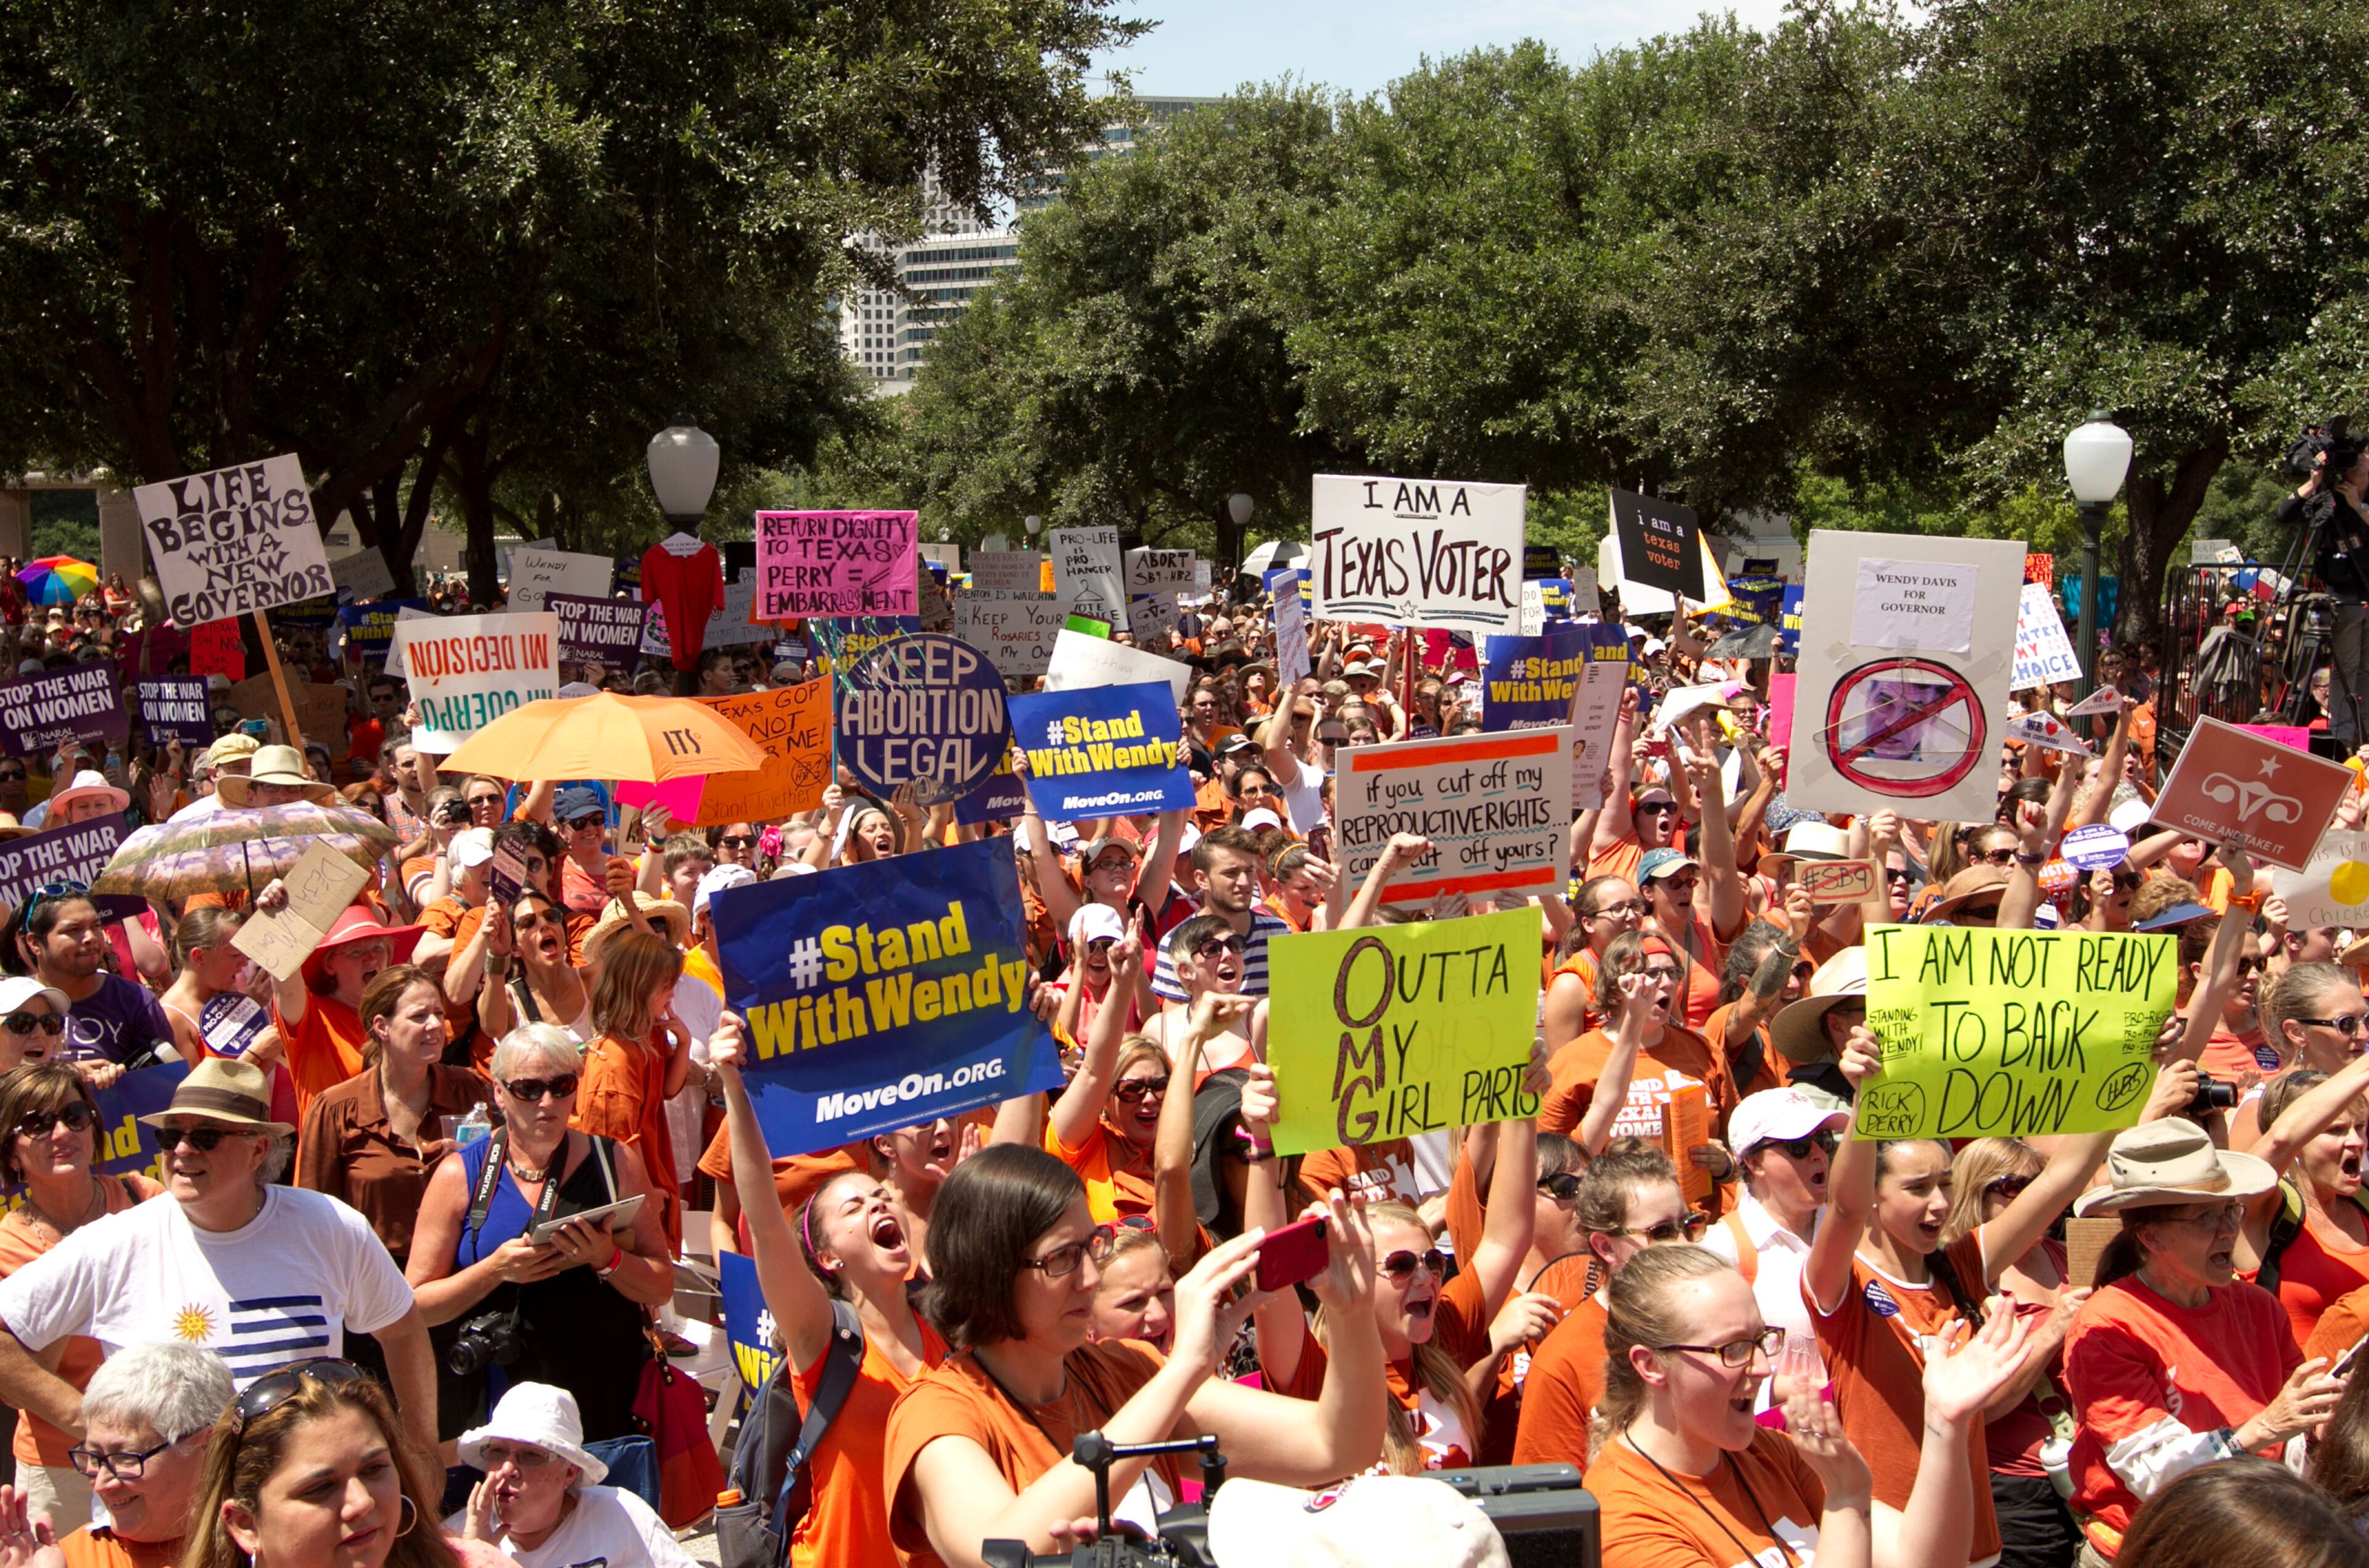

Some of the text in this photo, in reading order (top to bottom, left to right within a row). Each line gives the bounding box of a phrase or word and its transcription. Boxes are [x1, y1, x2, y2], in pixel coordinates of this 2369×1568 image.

[168, 463, 270, 518] LIFE
[1363, 481, 1471, 516] I AM A
[763, 517, 910, 543] RETURN DIGNITY
[1637, 510, 1684, 537] i am a
[187, 533, 282, 566] WITH A
[766, 538, 892, 563] TO TEXAS
[1060, 532, 1117, 545] PRO-LIFE
[1643, 532, 1681, 553] texas
[205, 551, 290, 590] NEW
[526, 556, 567, 571] WENDY
[1067, 566, 1114, 577] HANGER
[1136, 553, 1189, 569] ABORT
[1315, 527, 1518, 609] TEXAS VOTER
[1647, 550, 1681, 570] voter
[533, 574, 552, 582] FOR
[767, 562, 837, 590] PERRY
[1876, 574, 1957, 587] WENDY DAVIS
[171, 564, 330, 625] GOVERNOR
[766, 589, 912, 615] EMBARRASSMENT
[957, 589, 990, 598] DENTON
[996, 590, 1007, 600] IS
[1543, 595, 1569, 608] Wendy
[1904, 590, 1925, 600] FOR
[551, 600, 642, 624] STOP THE WAR
[972, 605, 1063, 625] KEEP YOUR
[1881, 603, 1945, 615] GOVERNOR
[581, 623, 639, 646] WOMEN
[992, 626, 1041, 642] ROSARIES
[2019, 624, 2059, 643] NTRY
[408, 635, 517, 686] DECISIÓN
[521, 633, 548, 669] MI
[576, 650, 604, 659] NARAL
[870, 640, 978, 689] KEEP
[1001, 646, 1019, 658] MY
[1511, 652, 1584, 679] #Stand
[0, 669, 109, 708] STOP THE WAR
[139, 683, 204, 699] STOP THE WAR
[706, 683, 819, 719] TEXAS GOP
[1490, 679, 1577, 703] WithWe
[4, 689, 114, 730] ON WOMEN
[143, 701, 205, 722] ON WOMEN
[842, 688, 1004, 736] ABORTION
[40, 727, 75, 740] NARAL
[76, 730, 104, 741] America
[750, 711, 804, 738] NOT
[1047, 710, 1144, 746] #Stand
[2026, 719, 2043, 732] WE
[663, 728, 701, 756] ITS
[787, 723, 825, 754] ME!
[2032, 733, 2059, 745] CUSTOMERS
[858, 738, 988, 785] LEGAL
[1027, 737, 1177, 777] WithWendy
[1366, 761, 1542, 809] if you cut off my
[703, 786, 816, 820] Stand Together
[2183, 814, 2284, 855] COME AND TAKE IT
[0, 826, 118, 880] OP THE WAR
[1461, 837, 1489, 864] off
[1495, 833, 1558, 872] yours?
[1803, 867, 1868, 894] #SB9
[98, 909, 113, 918] rica
[2309, 906, 2369, 925] Chicke
[789, 900, 971, 989] #Stand
[1873, 928, 2168, 1001] I AM NOT READY
[1334, 936, 1508, 1028] OUTTA
[746, 953, 1027, 1060] WithWendy
[1869, 1007, 1918, 1024] STANDING
[1874, 1021, 1908, 1038] WITH
[1930, 1000, 2099, 1073] TO BACK
[1333, 1020, 1418, 1102] MY
[1337, 1076, 1446, 1147] GIRL
[1867, 1091, 1909, 1112] RICK
[1937, 1068, 2080, 1134] DOWN
[1866, 1113, 1917, 1134] PERRY
[490, 1144, 500, 1163] EOS
[479, 1165, 494, 1201] DIGITAL
[541, 1178, 557, 1211] Canon
